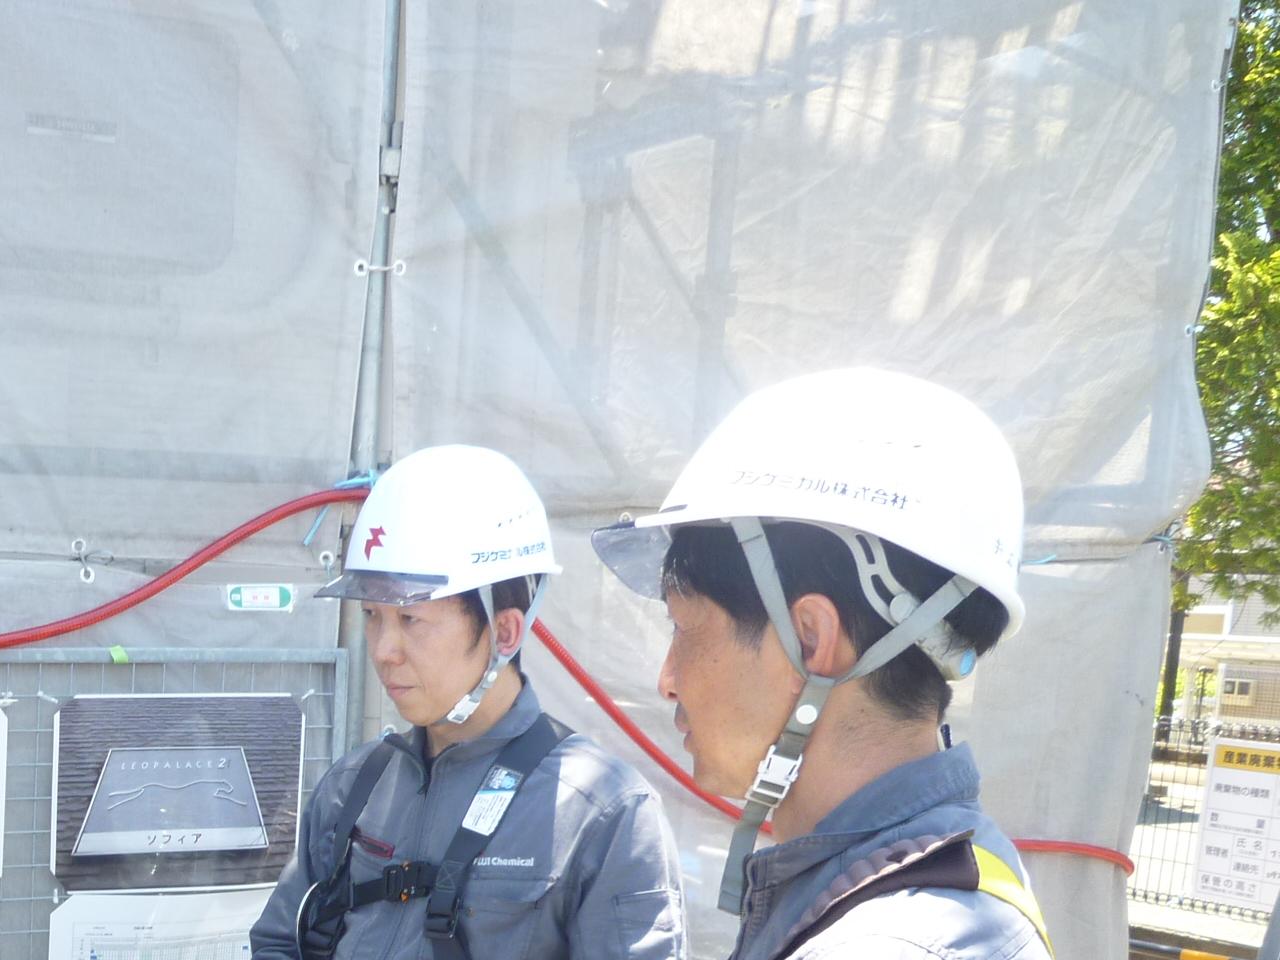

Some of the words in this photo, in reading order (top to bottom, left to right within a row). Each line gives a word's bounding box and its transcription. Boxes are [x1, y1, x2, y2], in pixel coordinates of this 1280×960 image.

[1223, 750, 1280, 769] 産業廃棄
[147, 833, 203, 846] ソフィア
